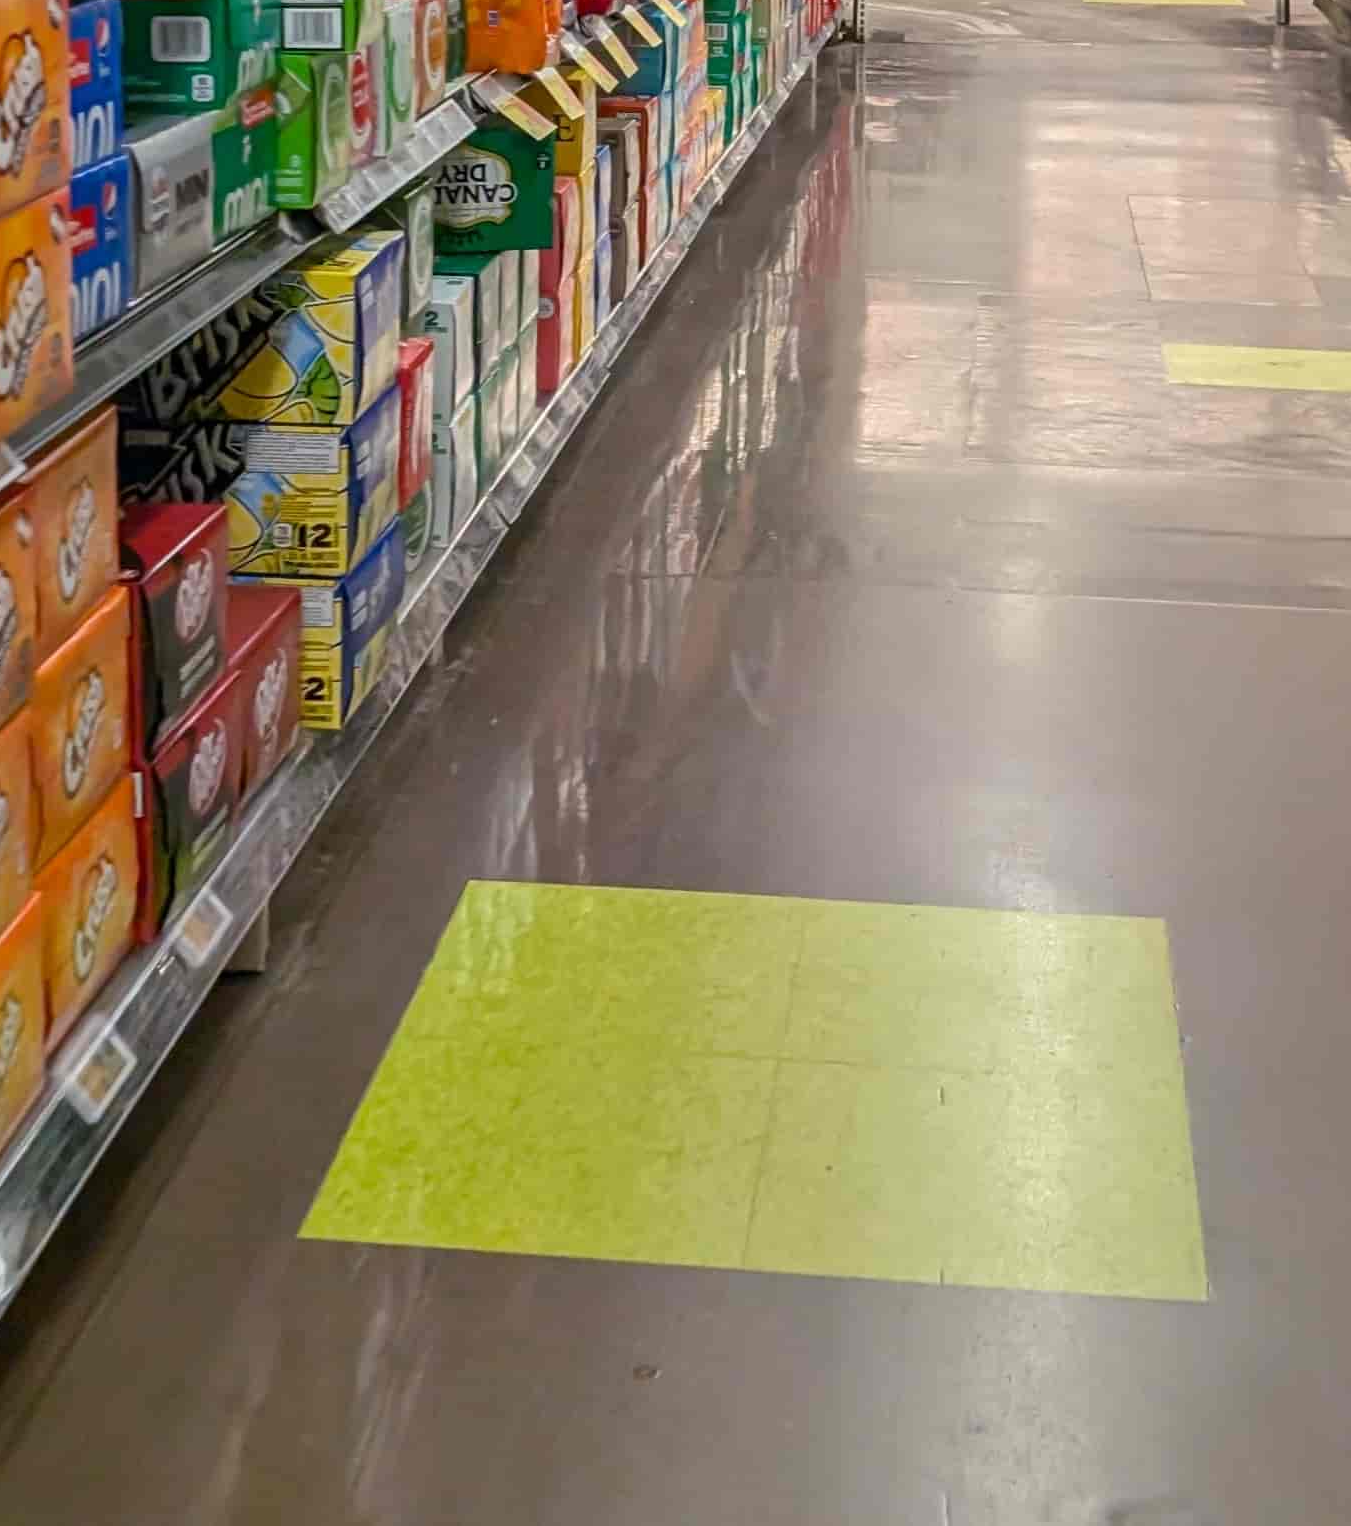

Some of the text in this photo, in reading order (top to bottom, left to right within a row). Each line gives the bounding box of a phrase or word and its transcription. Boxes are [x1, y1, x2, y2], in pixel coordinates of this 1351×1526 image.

[439, 163, 487, 183] DRY
[434, 184, 517, 205] CANA
[298, 524, 332, 548] 12
[302, 676, 326, 701] 2
